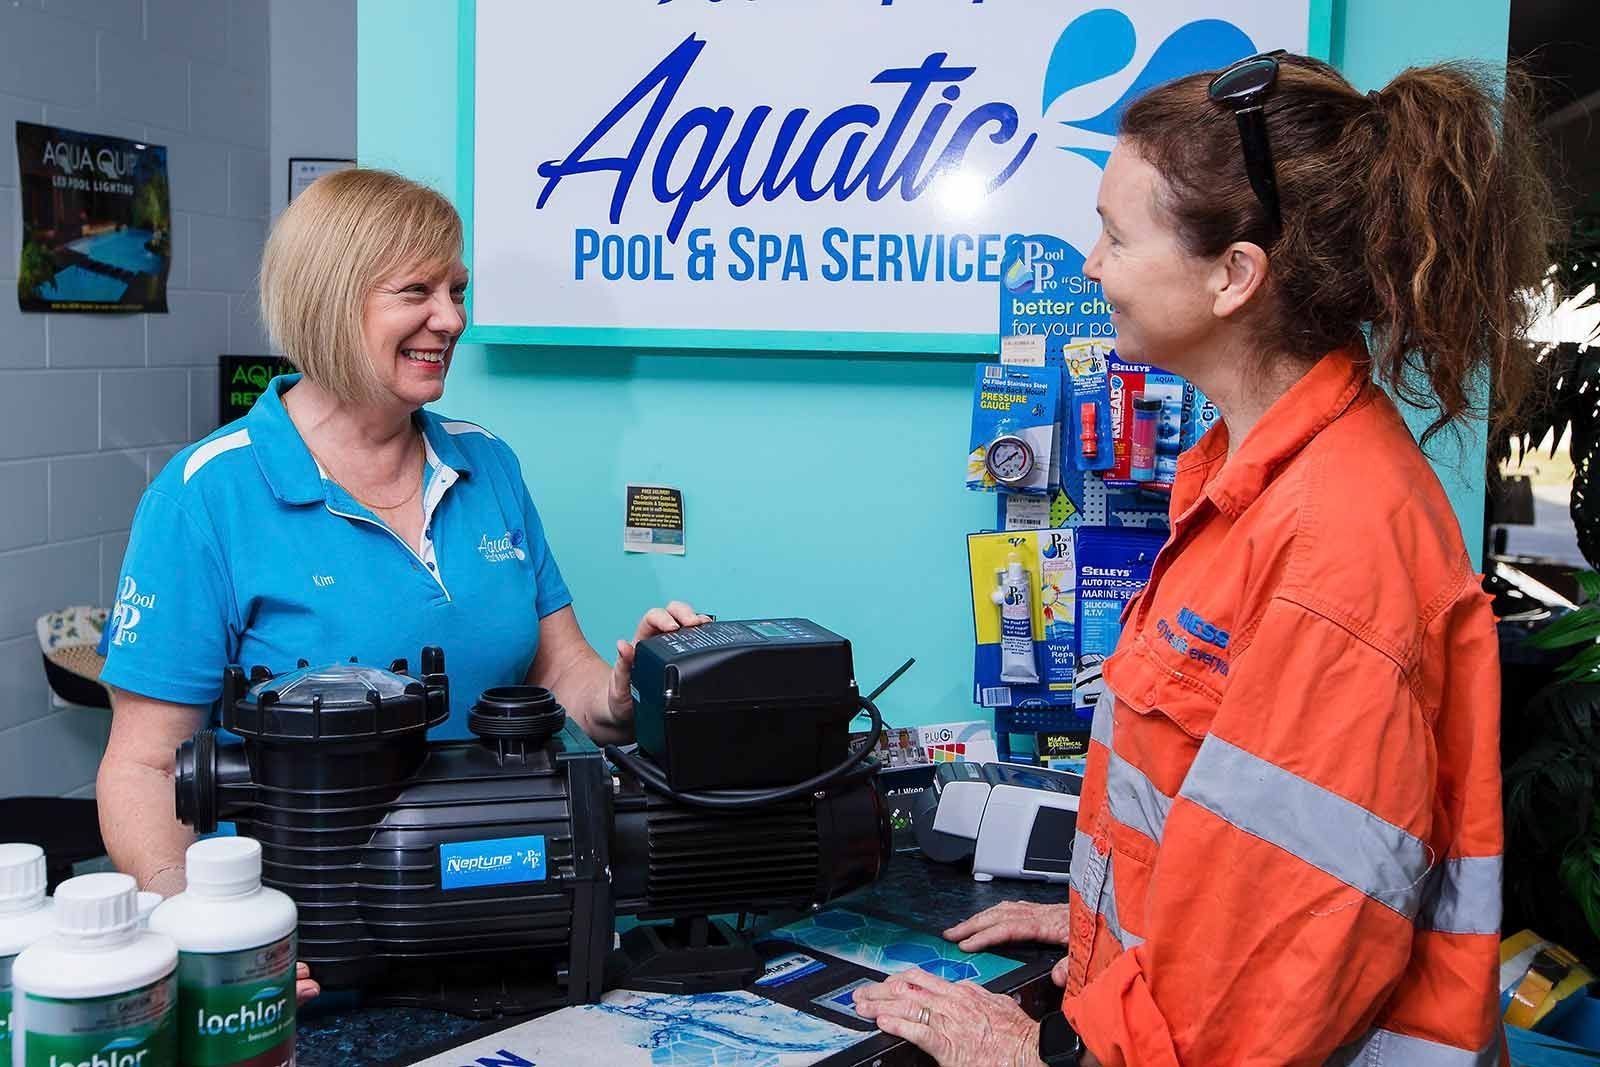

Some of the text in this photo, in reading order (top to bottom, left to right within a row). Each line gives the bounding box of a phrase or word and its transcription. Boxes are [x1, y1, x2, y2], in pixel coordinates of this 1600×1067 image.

[535, 31, 1038, 244] Aquatic
[42, 141, 95, 175] AQUA
[67, 177, 90, 191] POOL
[93, 180, 134, 196] LIGHTING
[575, 226, 1024, 282] POOL & SPA SERVICE
[1022, 241, 1064, 273] Pool
[1031, 263, 1057, 293] Pro
[1013, 298, 1074, 315] better
[1012, 319, 1036, 336] for
[1042, 322, 1084, 341] your
[1111, 362, 1151, 373] SELLEYS
[1007, 380, 1032, 388] Stainless
[980, 400, 1011, 412] GAUGE
[981, 392, 1028, 403] PRESSURE
[1051, 533, 1072, 547] Pool
[1057, 543, 1070, 558] Pro
[1082, 566, 1130, 576] SELLEYS
[120, 576, 156, 608] Pool
[1082, 590, 1118, 599] MARINE
[112, 604, 141, 646] Pro
[1048, 644, 1070, 652] Vinyl
[448, 855, 512, 872] Neptune
[198, 998, 287, 1036] lochlor
[49, 1049, 148, 1067] hlor
